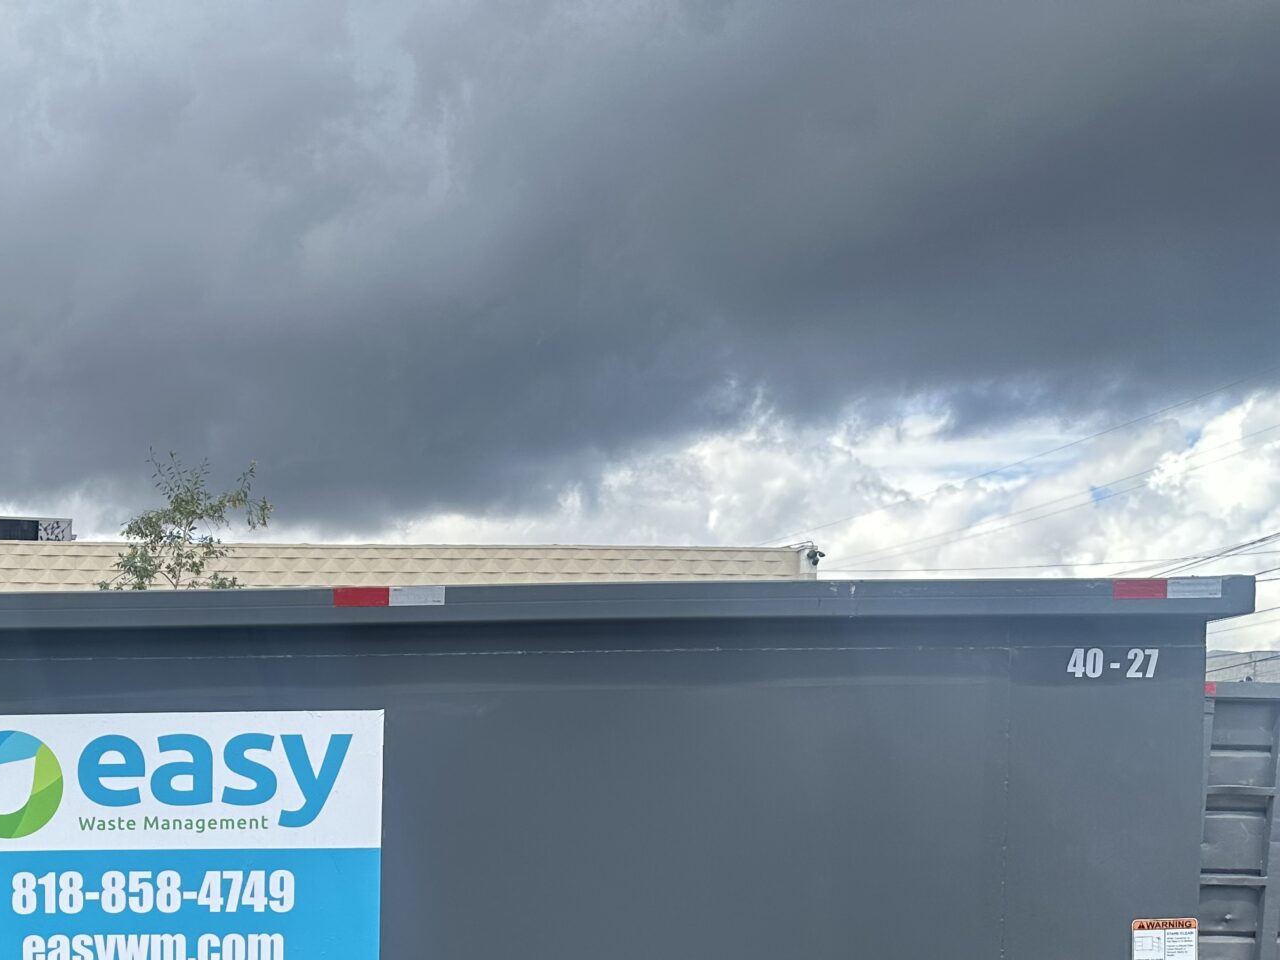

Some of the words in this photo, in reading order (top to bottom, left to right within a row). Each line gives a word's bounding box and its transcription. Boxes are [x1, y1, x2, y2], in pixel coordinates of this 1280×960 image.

[1066, 648, 1104, 678] 40
[1126, 648, 1159, 678] 27
[77, 732, 354, 829] easy
[78, 816, 137, 832] Waste
[143, 814, 269, 834] Management
[11, 869, 296, 915] 818-858-4749
[1146, 921, 1192, 929] WARNING
